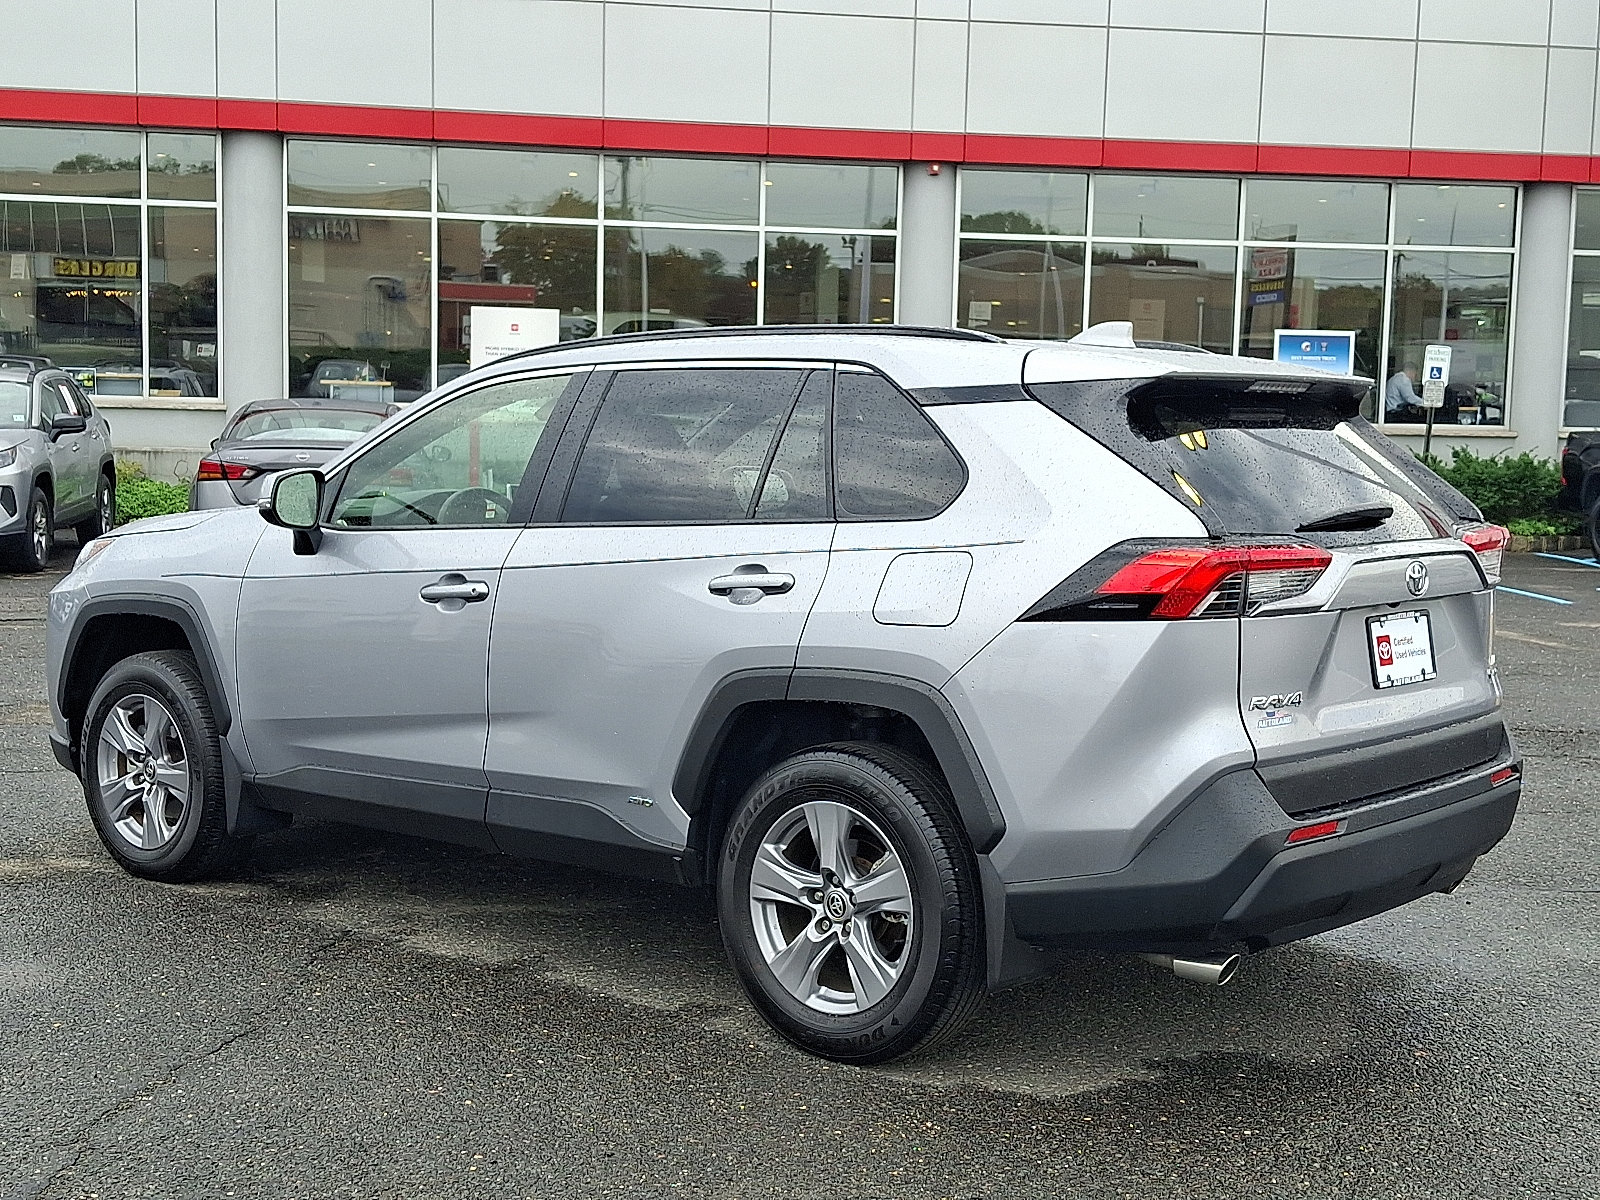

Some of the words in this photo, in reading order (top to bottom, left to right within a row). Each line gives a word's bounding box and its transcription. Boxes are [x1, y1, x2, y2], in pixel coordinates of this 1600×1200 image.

[1393, 635, 1413, 646] Certified
[1395, 649, 1407, 659] Used
[1408, 648, 1427, 657] Vehicles
[1249, 690, 1303, 711] RAV4
